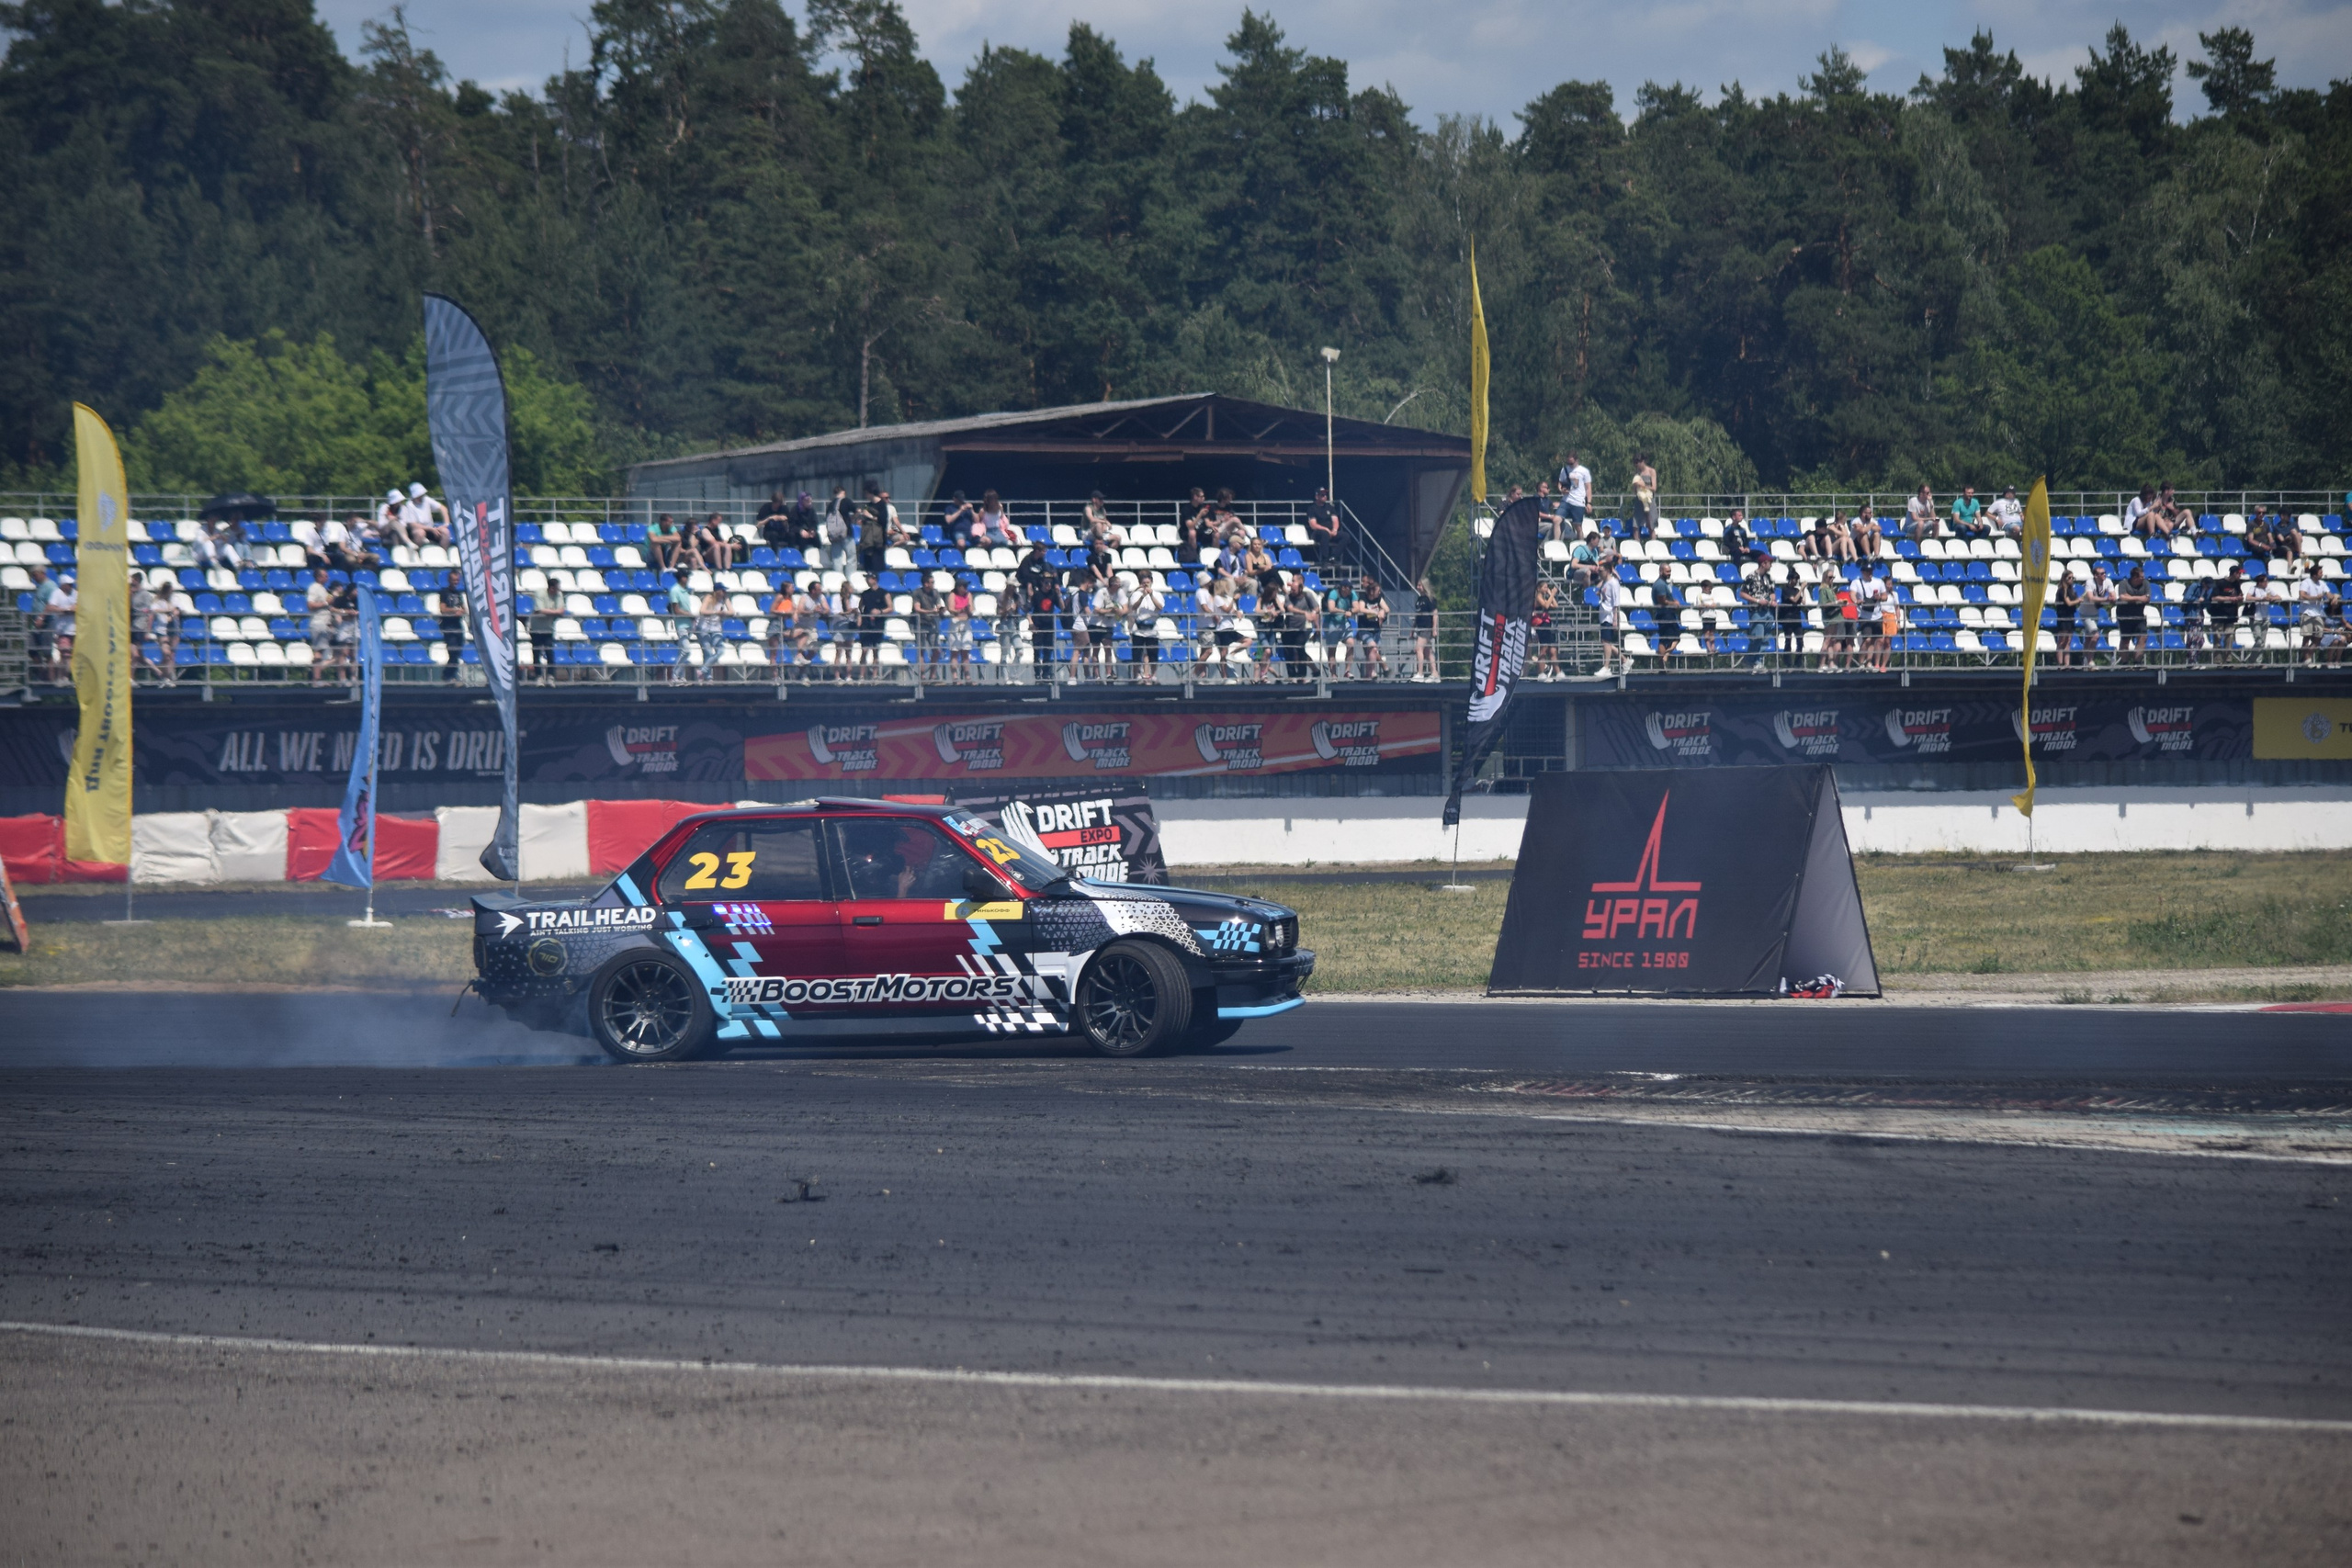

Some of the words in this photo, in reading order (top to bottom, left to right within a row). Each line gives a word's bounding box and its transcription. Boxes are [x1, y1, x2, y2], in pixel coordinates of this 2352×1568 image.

[1475, 608, 1495, 692] DRIFT
[1498, 617, 1517, 683] TRACK
[1511, 616, 1527, 676] MODE
[1664, 712, 1711, 728] DRIFT
[1792, 711, 1838, 728] DRIFT
[1904, 709, 1951, 726] DRIFT
[2030, 707, 2077, 724] DRIFT
[2146, 707, 2194, 724] DRIFT
[627, 726, 679, 743] DRIFT
[827, 726, 878, 743] DRIFT
[955, 724, 1003, 740] DRIFT
[1081, 723, 1131, 740] DRIFT
[1214, 725, 1263, 741] DRIFT
[1330, 721, 1379, 739] DRIFT
[2039, 731, 2075, 741] TRACK
[2154, 730, 2192, 741] TRACK
[1673, 736, 1709, 746] TRACK
[1800, 734, 1837, 745] TRACK
[1912, 734, 1950, 744] TRACK
[2043, 741, 2077, 750] MODE
[2161, 740, 2194, 750] MODE
[219, 731, 267, 772] ALL
[279, 731, 325, 772] WE
[412, 731, 441, 771] IS
[1090, 748, 1128, 759] TRACK
[1222, 749, 1260, 759] TRACK
[1339, 747, 1378, 757] TRACK
[1678, 745, 1711, 756] MODE
[1805, 744, 1838, 755] MODE
[1917, 742, 1951, 752] MODE
[636, 750, 676, 761] TRACK
[837, 750, 876, 761] TRACK
[961, 750, 1001, 761] TRACK
[1095, 757, 1131, 768] MODE
[1345, 755, 1380, 766] MODE
[641, 761, 679, 773] MODE
[842, 760, 877, 772] MODE
[968, 758, 1003, 770] MODE
[1227, 758, 1263, 770] MODE
[1035, 798, 1114, 833] DRIFT
[1080, 828, 1113, 843] EXPO
[1061, 844, 1123, 869] TRACK
[684, 851, 756, 890] 23
[526, 907, 656, 930] TRAILHEAD
[1582, 898, 1699, 939] УРАЛ
[530, 929, 552, 937] AIN'T
[555, 927, 589, 935] TALKING
[592, 925, 611, 933] JUST
[613, 923, 653, 932] WORKING
[1577, 952, 1635, 968] SINCE
[1641, 952, 1690, 968] 1900
